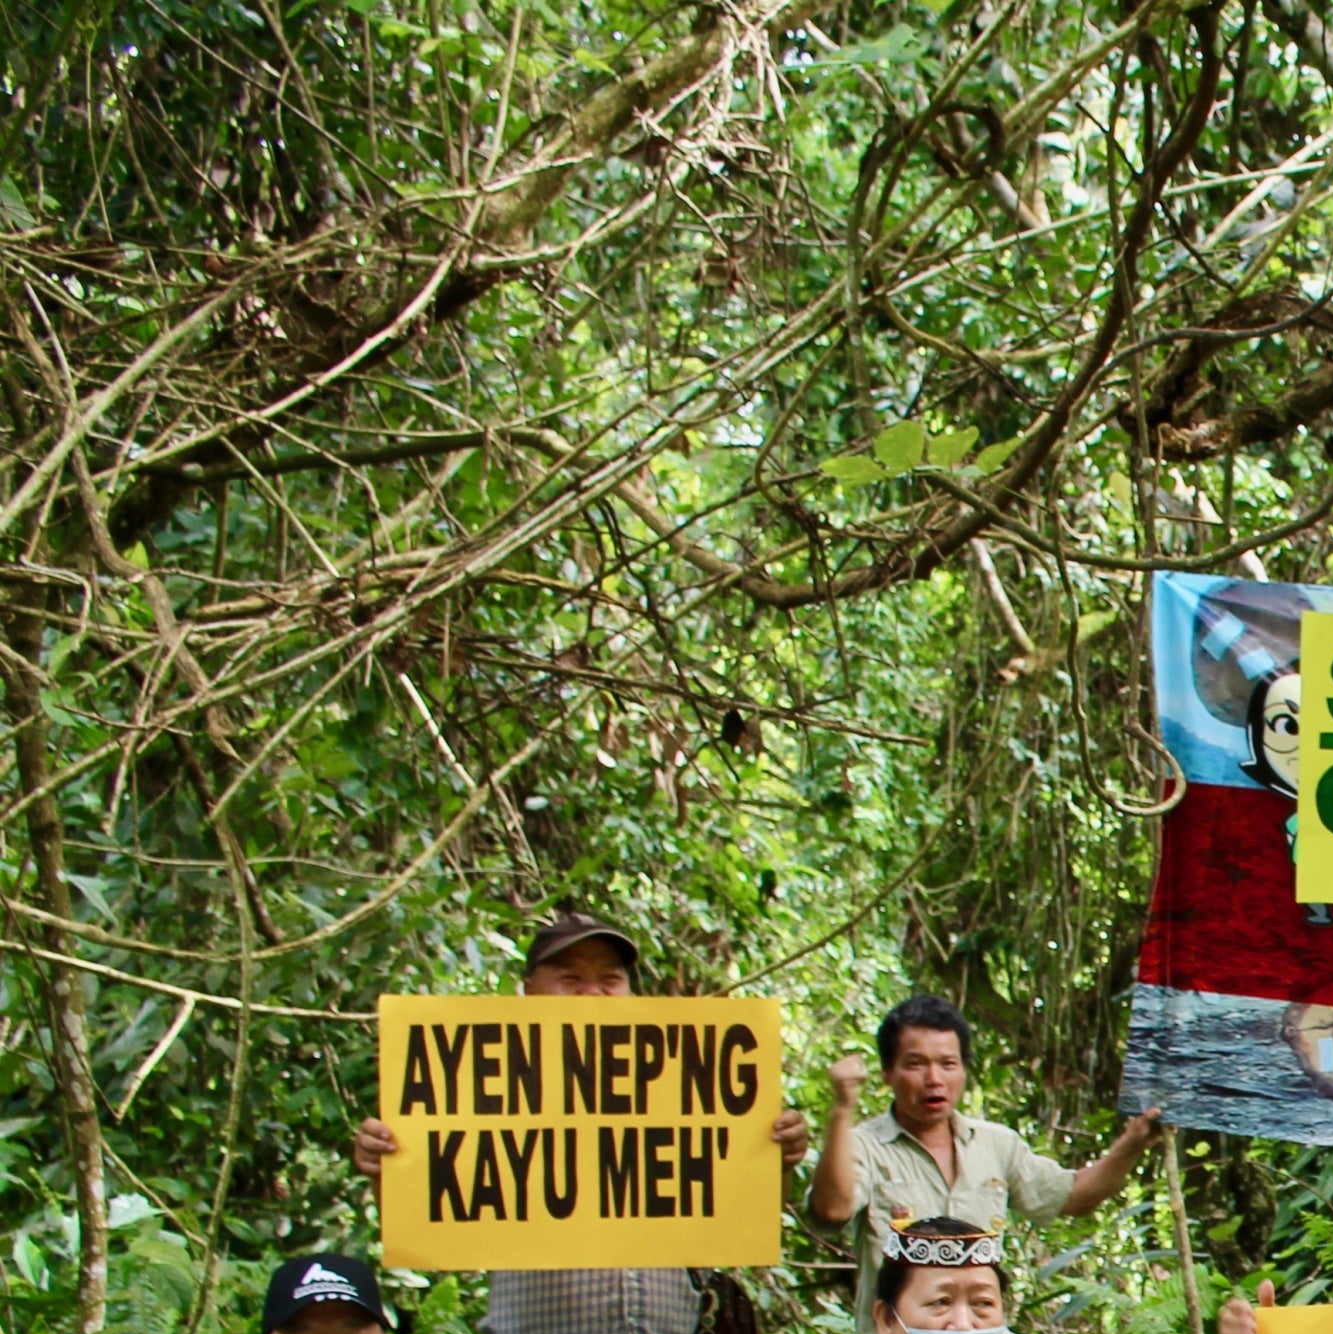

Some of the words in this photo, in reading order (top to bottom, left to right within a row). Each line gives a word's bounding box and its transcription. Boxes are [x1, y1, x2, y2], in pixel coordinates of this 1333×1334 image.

[400, 1023, 543, 1117] AYEN
[562, 1024, 758, 1117] NEP'NG
[428, 1128, 578, 1222] KAYU
[599, 1126, 729, 1219] MEH'
